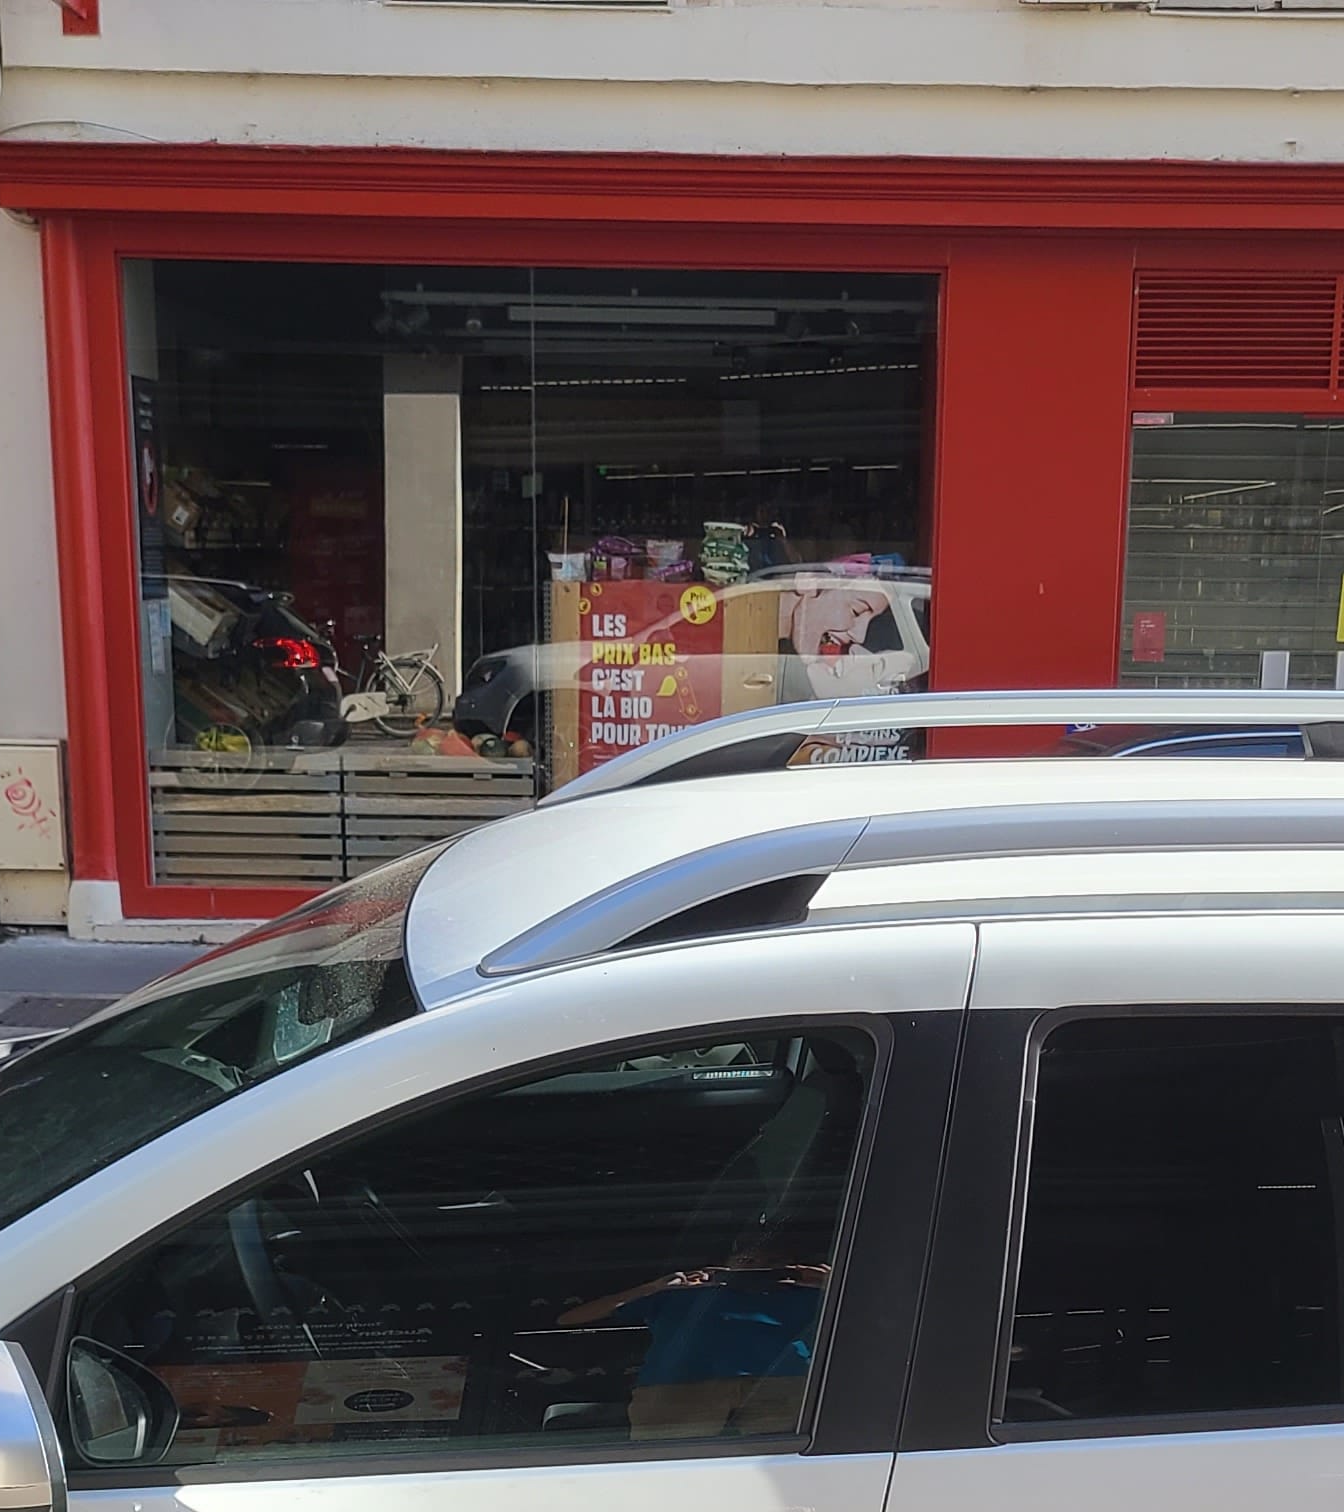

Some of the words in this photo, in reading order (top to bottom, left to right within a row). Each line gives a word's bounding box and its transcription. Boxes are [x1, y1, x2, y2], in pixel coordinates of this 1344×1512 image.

[592, 614, 627, 637] LES
[592, 642, 634, 665] PRIX
[639, 643, 676, 665] BAS
[592, 668, 645, 692] C'EST
[592, 696, 615, 718] LA
[620, 697, 653, 719] BIO
[592, 722, 641, 745] POUR
